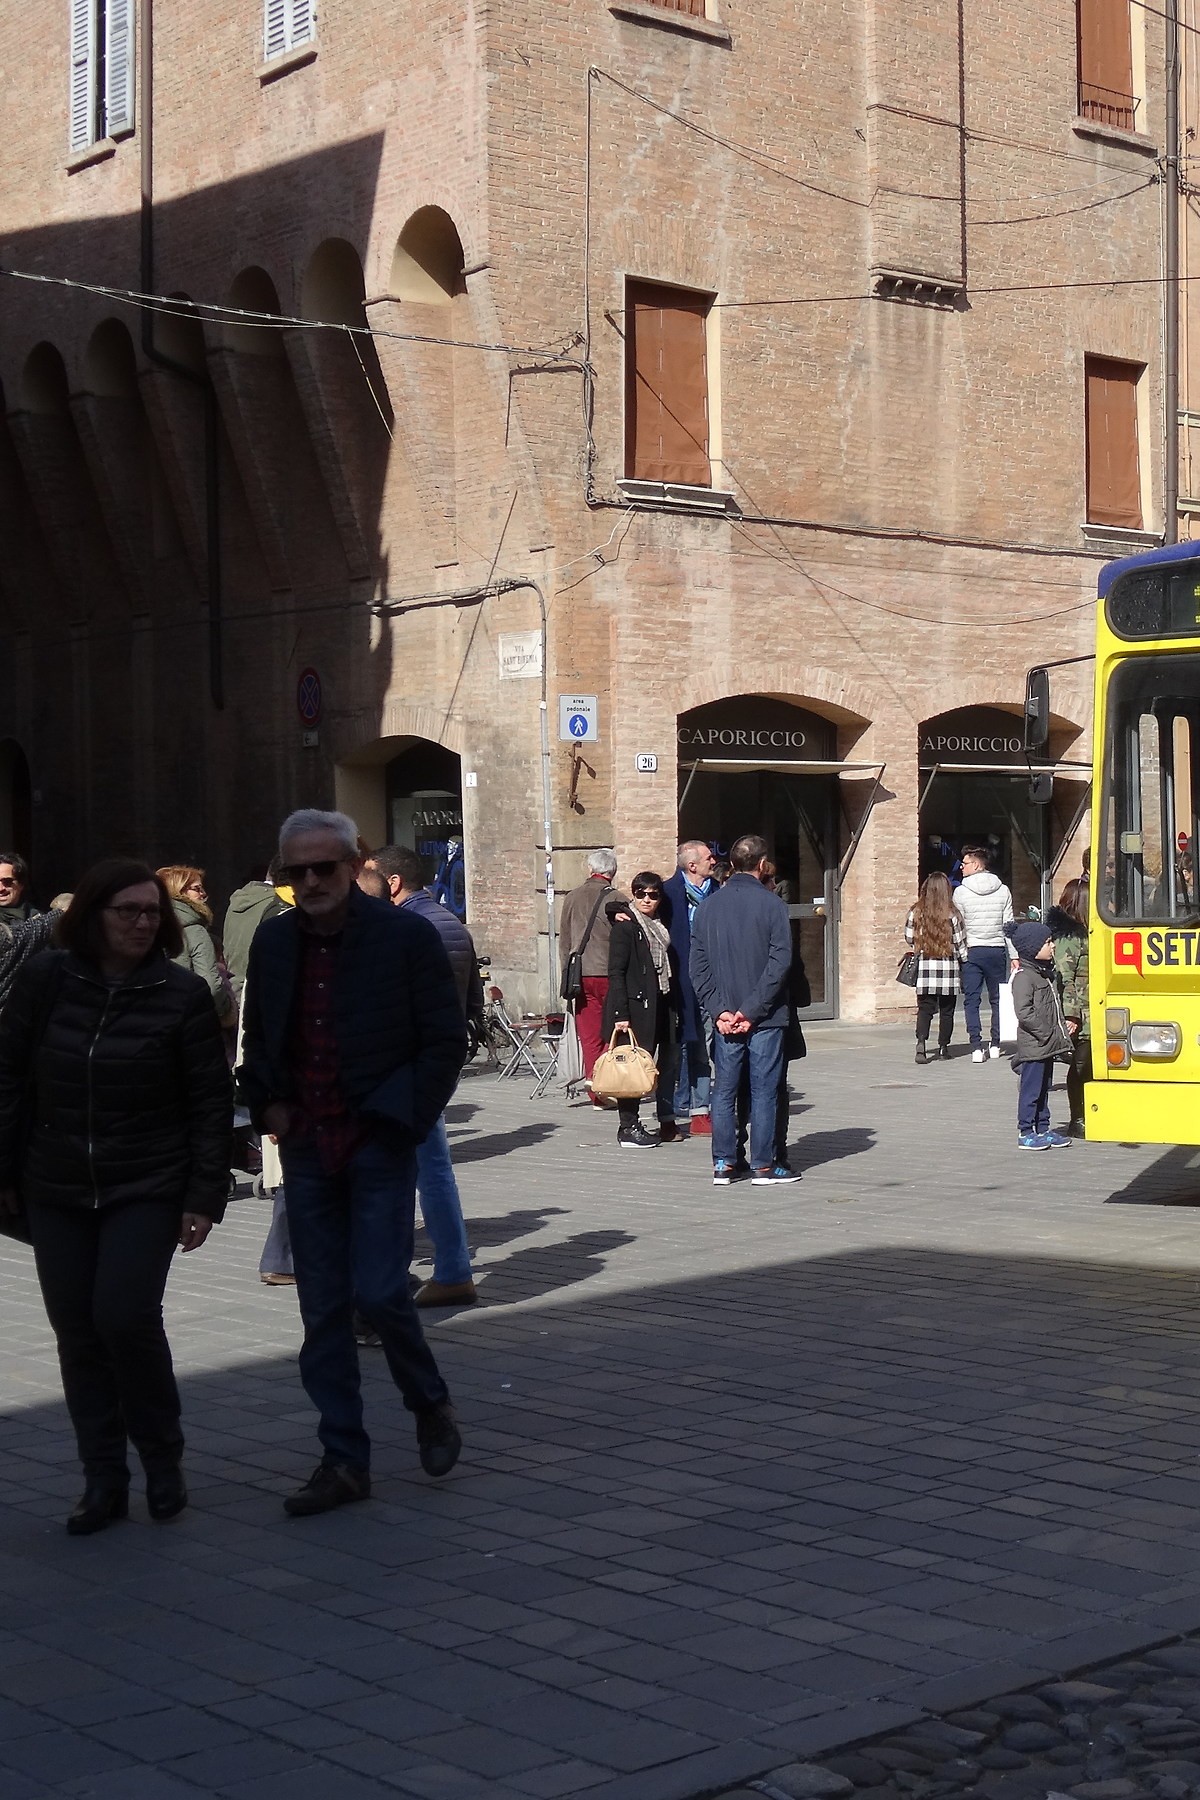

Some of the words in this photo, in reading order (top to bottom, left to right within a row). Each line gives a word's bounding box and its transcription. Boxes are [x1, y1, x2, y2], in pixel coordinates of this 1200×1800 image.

[677, 728, 806, 748] CAPORICCIO
[918, 736, 1021, 752] APORICCIO
[642, 757, 653, 769] 26
